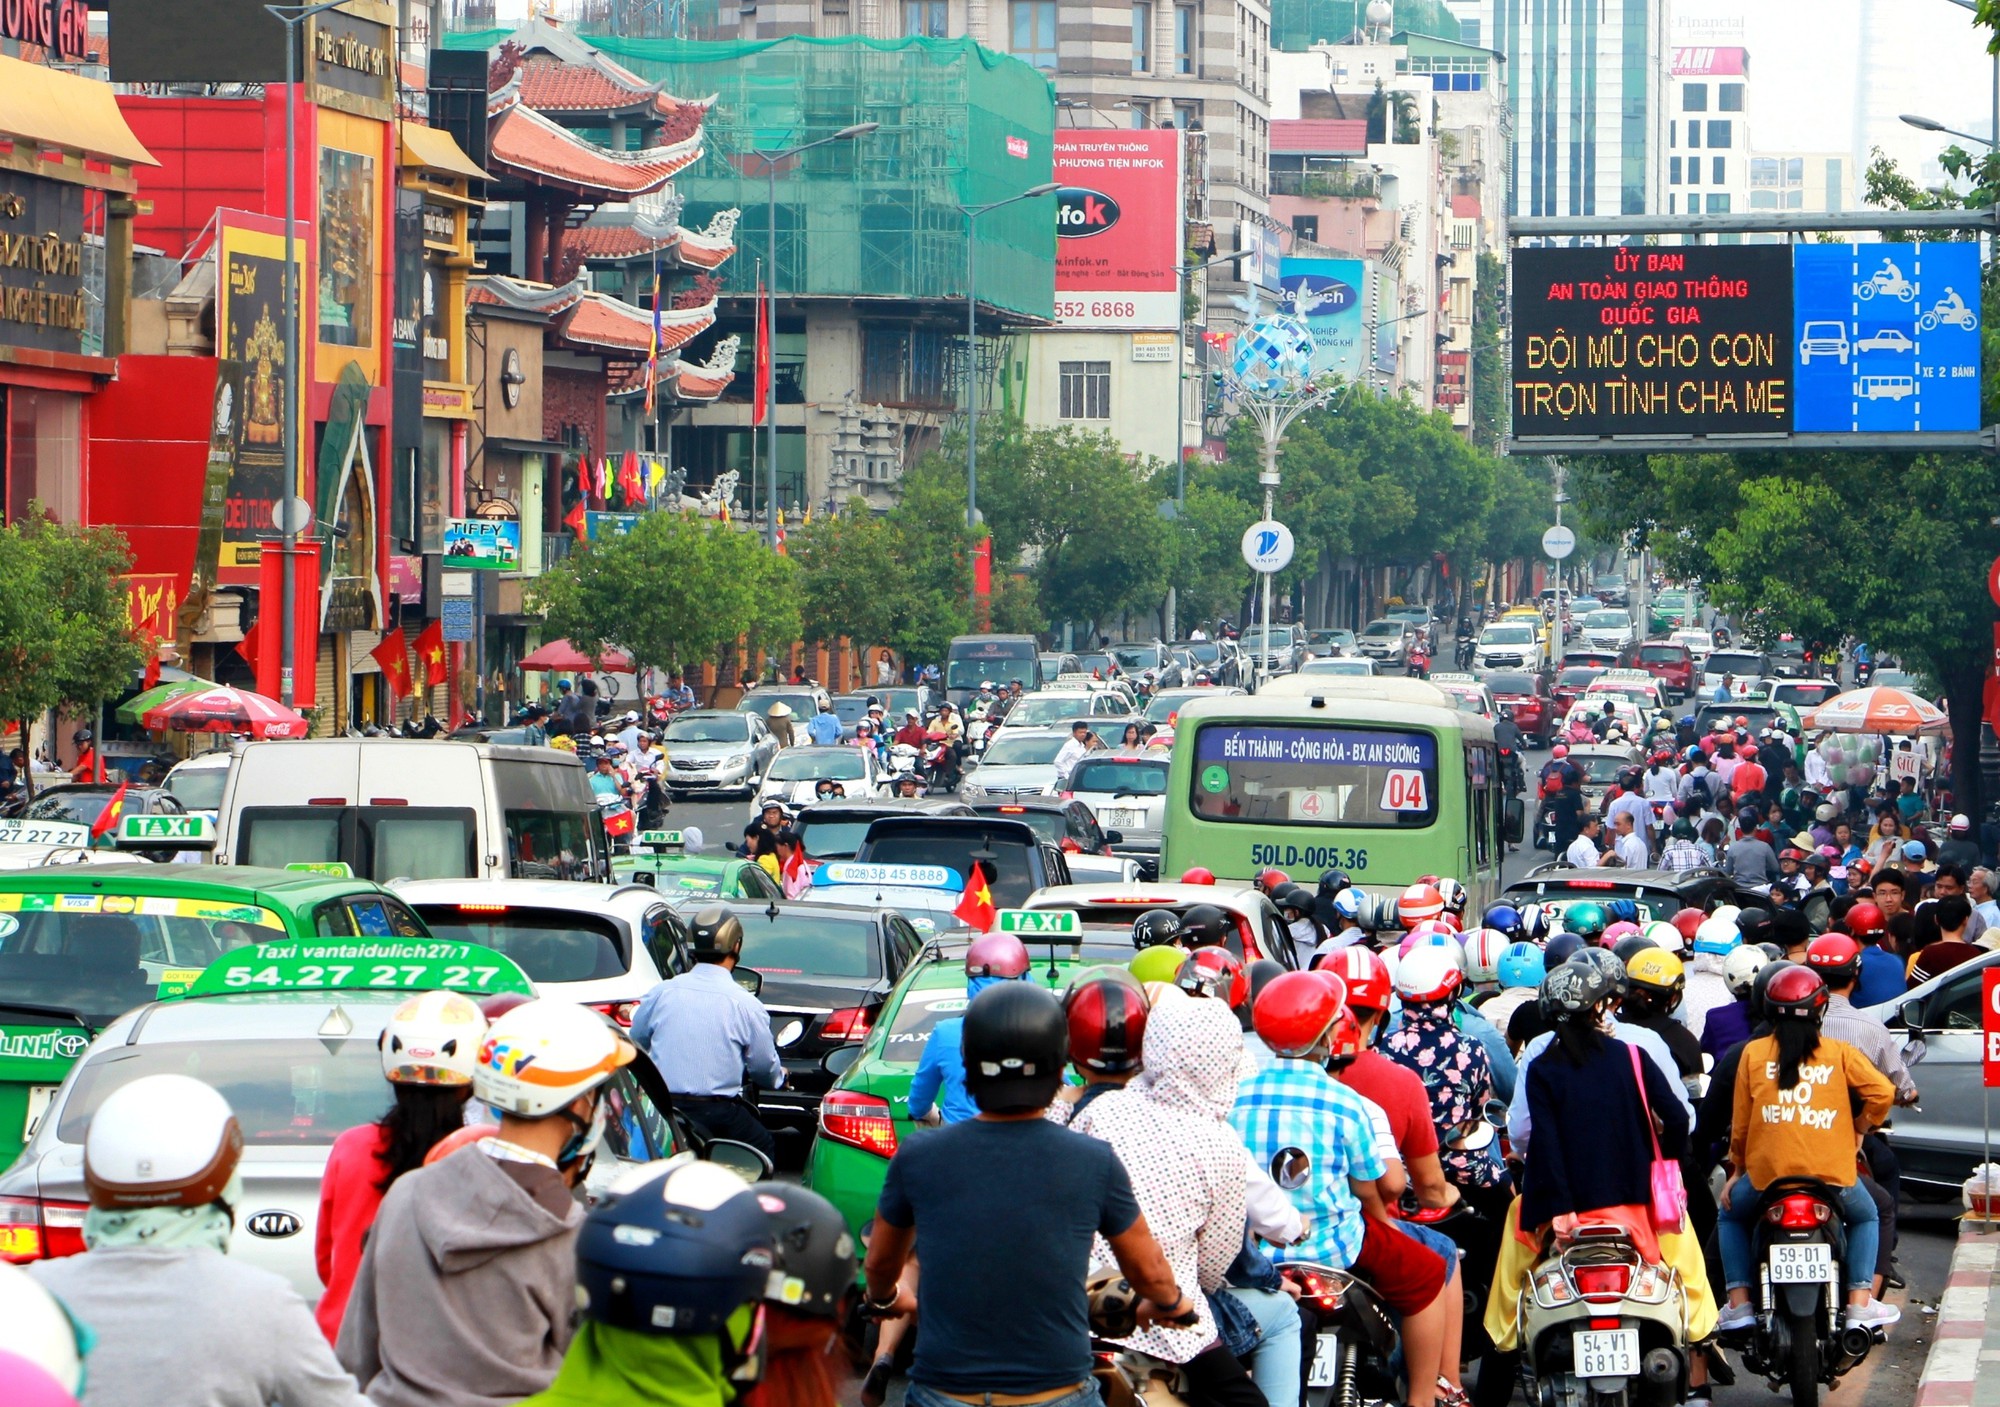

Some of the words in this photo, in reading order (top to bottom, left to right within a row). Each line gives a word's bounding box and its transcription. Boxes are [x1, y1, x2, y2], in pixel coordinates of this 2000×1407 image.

[1060, 158, 1105, 168] PHƯƠNG
[1132, 159, 1164, 168] INFOK
[1614, 247, 1640, 272] ỦY
[1647, 254, 1684, 272] BAN
[1547, 282, 1573, 300] AN
[1578, 275, 1627, 300] TOÀN
[1633, 281, 1678, 299] GIAO
[1683, 275, 1748, 299] THÔNG
[1091, 302, 1135, 318] 6868
[1600, 300, 1655, 325] QUỐC
[1666, 306, 1701, 324] GIA
[1527, 327, 1577, 375] ĐỘI
[1588, 327, 1628, 368] MŨ
[1637, 334, 1699, 368] CHO
[1710, 333, 1773, 367] CON
[1923, 366, 1934, 378] XE
[1939, 366, 1947, 378] 2
[1951, 363, 1976, 378] BÁNH
[1515, 382, 1597, 421] TRỌN
[1604, 374, 1668, 415] TÌNH
[1677, 381, 1738, 414] CHA
[1746, 380, 1785, 419] MẸ
[452, 522, 503, 536] TIFFY
[1873, 703, 1910, 717] 3G
[1224, 732, 1246, 757] BẾN
[1247, 736, 1284, 760] THÀNH
[1290, 737, 1320, 762] CỘNG
[1322, 738, 1345, 761] HÒA
[1352, 745, 1367, 762] BX
[1368, 746, 1383, 762] AN
[1384, 744, 1421, 764] SƯƠNG
[1389, 774, 1422, 808] 04
[1302, 794, 1320, 815] 4
[28, 830, 52, 843] 27
[58, 831, 82, 844] 27
[1252, 844, 1368, 870] 50LD-005.36
[845, 868, 869, 880] (028)
[870, 868, 887, 880] 38
[890, 869, 907, 880] 45
[910, 870, 943, 881] 8888
[256, 944, 298, 959] Taxi
[224, 965, 356, 986] 54.27
[368, 965, 428, 986] 27
[442, 966, 500, 987] 27
[1778, 1081, 1812, 1104] NO
[1762, 1104, 1796, 1123] NEW
[1797, 1104, 1838, 1129] YORY
[255, 1216, 293, 1233] KIA
[1779, 1247, 1820, 1263] 59-D1
[1774, 1264, 1828, 1280] 996.85
[1583, 1333, 1627, 1353] 54-V1
[1584, 1353, 1630, 1373] 6813
